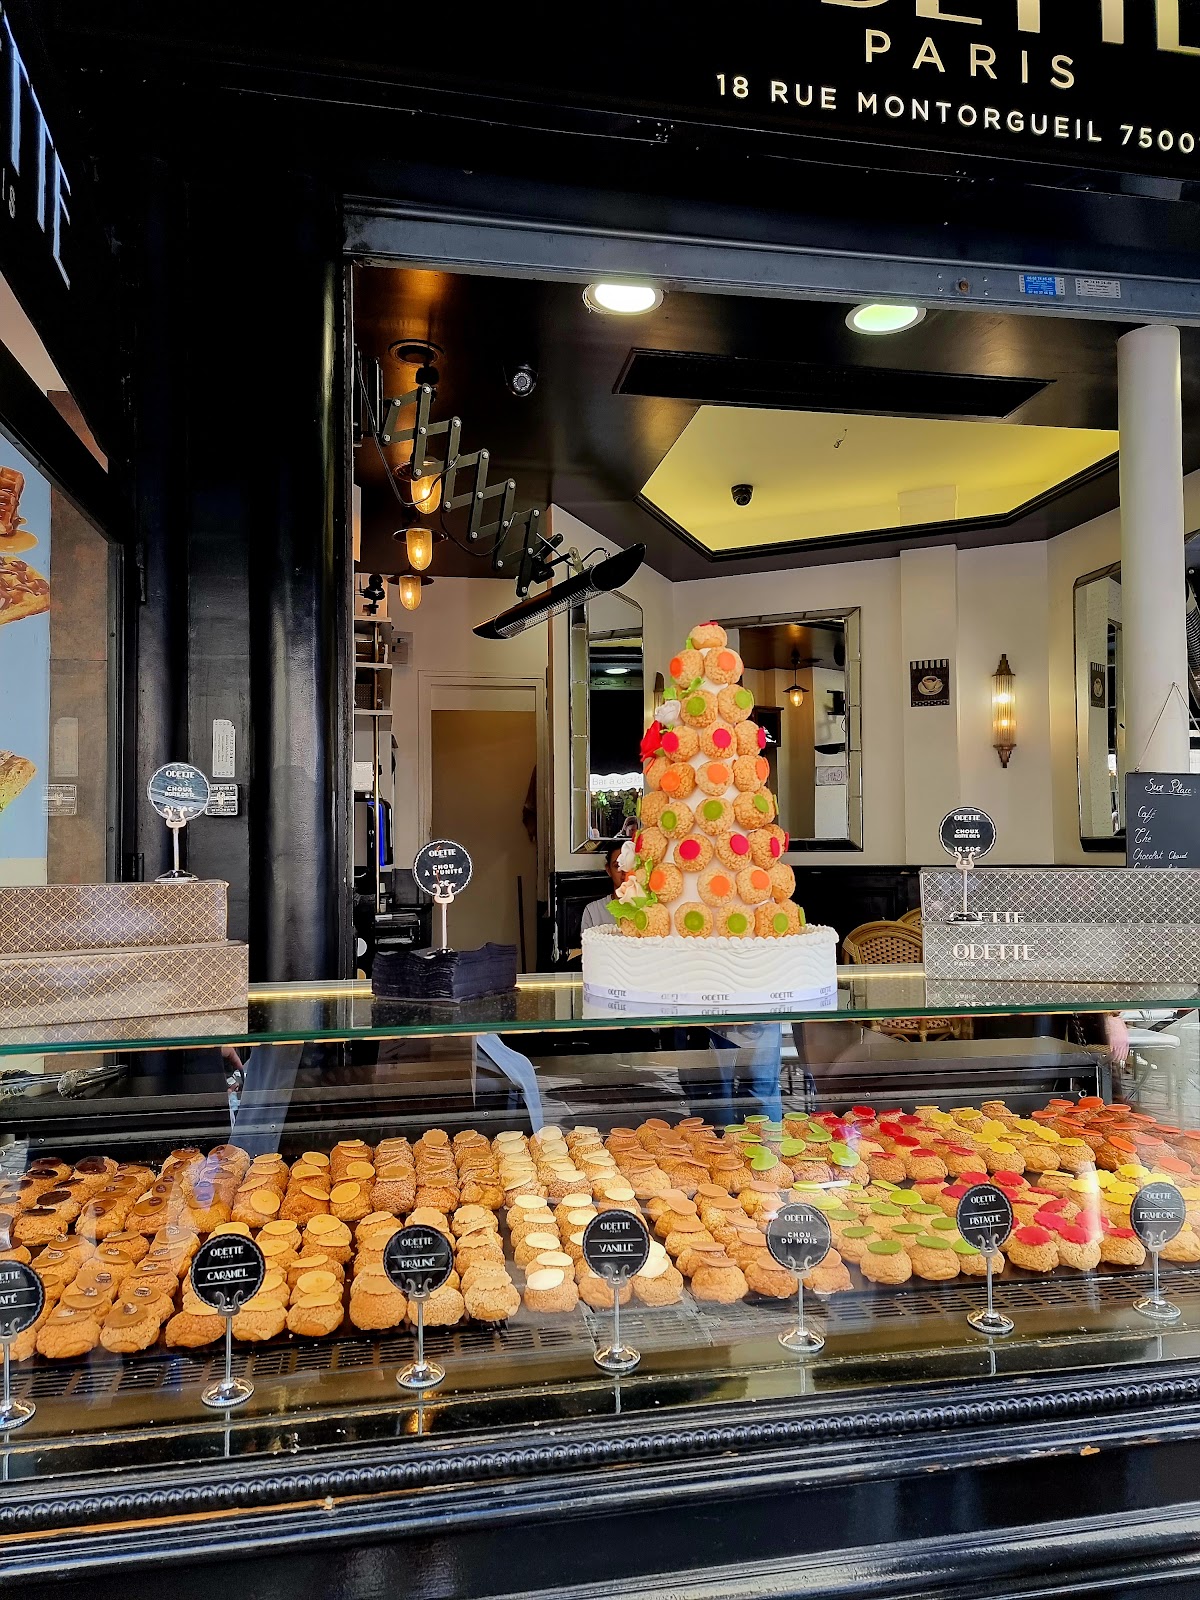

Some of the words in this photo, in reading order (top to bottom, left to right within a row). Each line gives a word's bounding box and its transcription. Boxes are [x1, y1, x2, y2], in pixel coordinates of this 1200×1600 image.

[864, 28, 1076, 90] PARIS
[716, 73, 750, 99] 18
[771, 80, 838, 111] RUE
[857, 91, 1103, 144] MONTORGUEIL
[1119, 124, 1200, 155] 7500
[165, 770, 195, 778] ODETTE
[428, 849, 456, 857] ODETTE
[952, 943, 1036, 961] ODETTE
[607, 988, 627, 997] ODETTE
[769, 991, 794, 1000] ODETTE
[970, 1194, 997, 1204] ODETTE
[784, 1214, 814, 1222] ODETTE
[600, 1221, 631, 1231] ODETTE
[401, 1236, 434, 1247] ODETTE
[210, 1245, 244, 1257] ODETTE
[598, 1243, 634, 1253] VANILLE
[401, 1256, 436, 1270] PRALINÉ
[207, 1267, 249, 1281] CARAMEL
